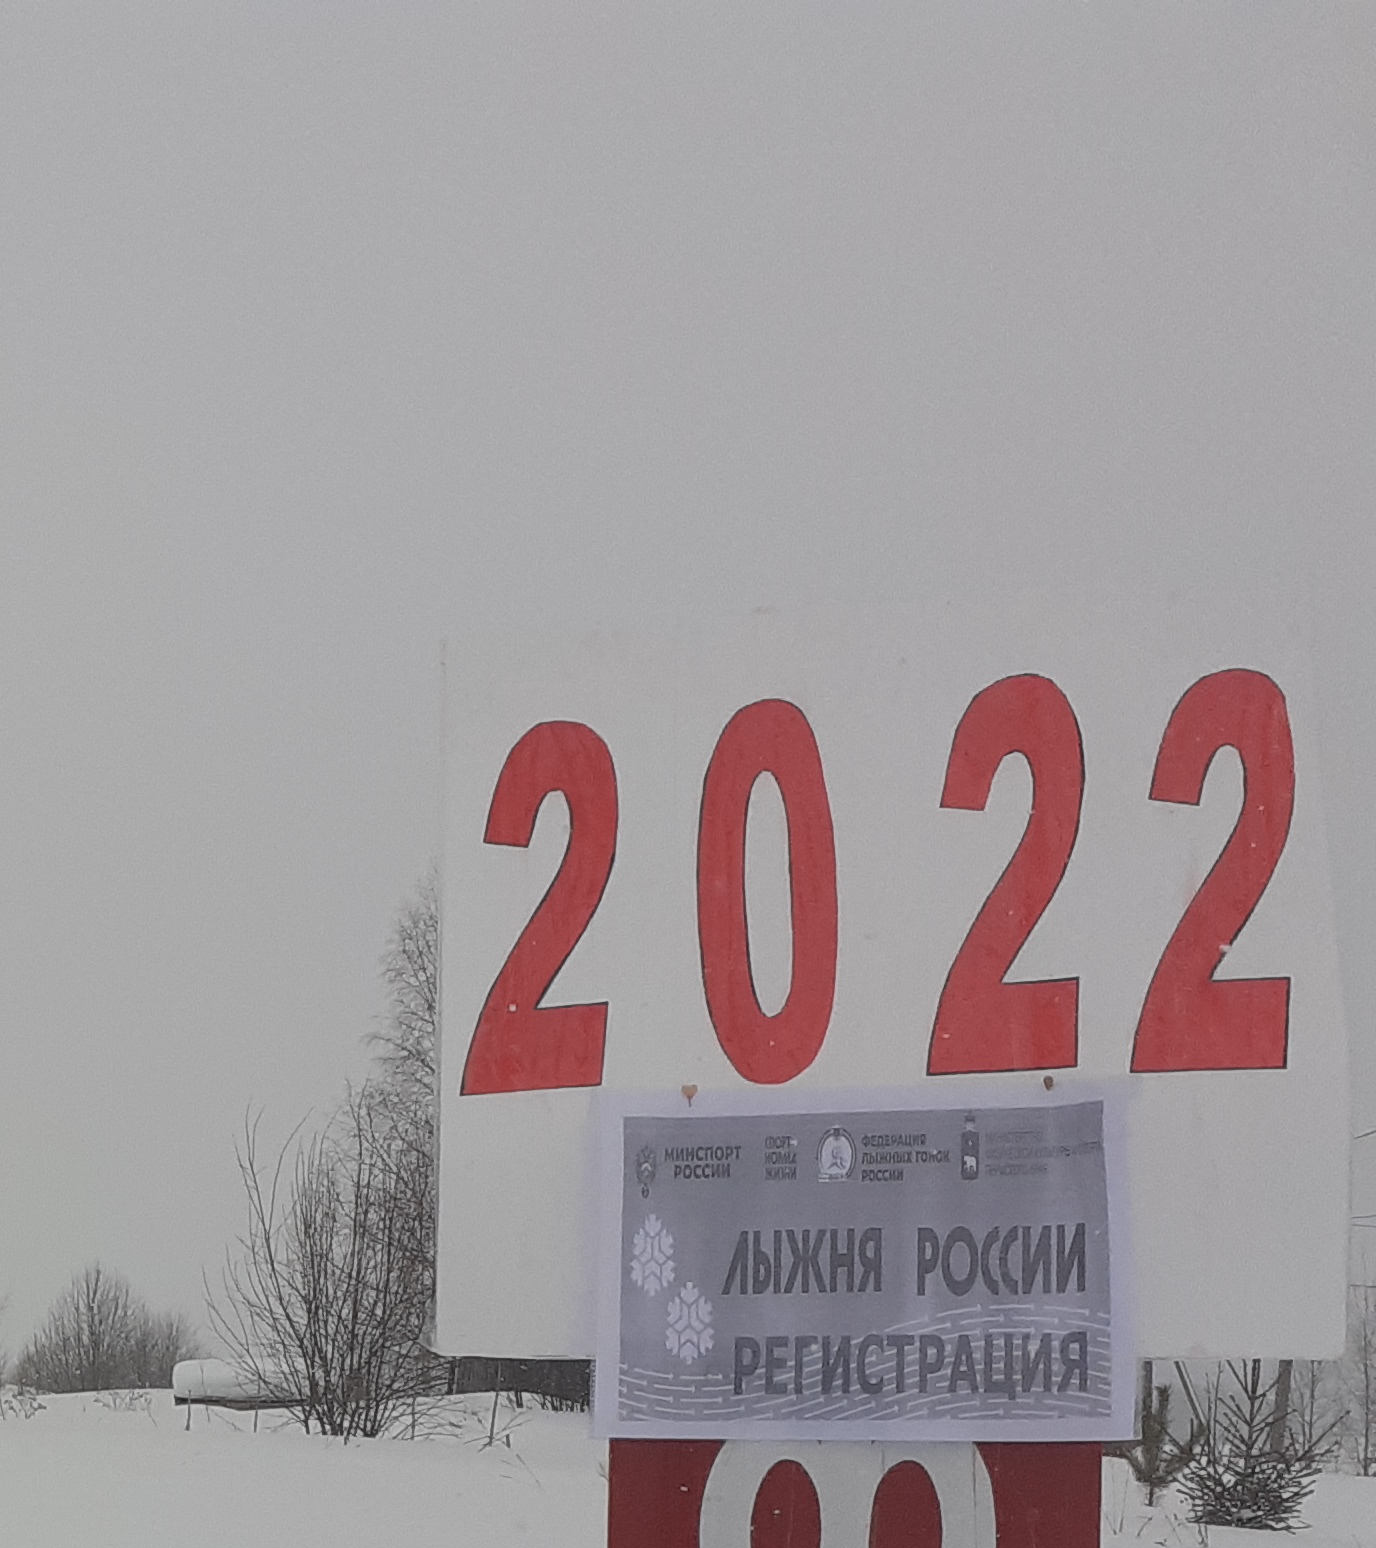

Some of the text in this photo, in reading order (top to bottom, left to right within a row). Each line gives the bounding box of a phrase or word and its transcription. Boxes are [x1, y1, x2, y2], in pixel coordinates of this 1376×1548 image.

[460, 668, 1296, 1096] 2022
[861, 1133, 927, 1147] ФЕДЕРАЦИЯ
[664, 1145, 742, 1162] МИНСПОРТ
[861, 1150, 951, 1165] ЛЫЖНЫХ ГОНОК
[674, 1164, 731, 1180] РОССИИ
[861, 1169, 904, 1182] РОССИИ
[721, 1222, 1087, 1296] ЛЫЖНЯ РОССИИ
[733, 1331, 1089, 1401] РЕГИСТРАЦИЯ
